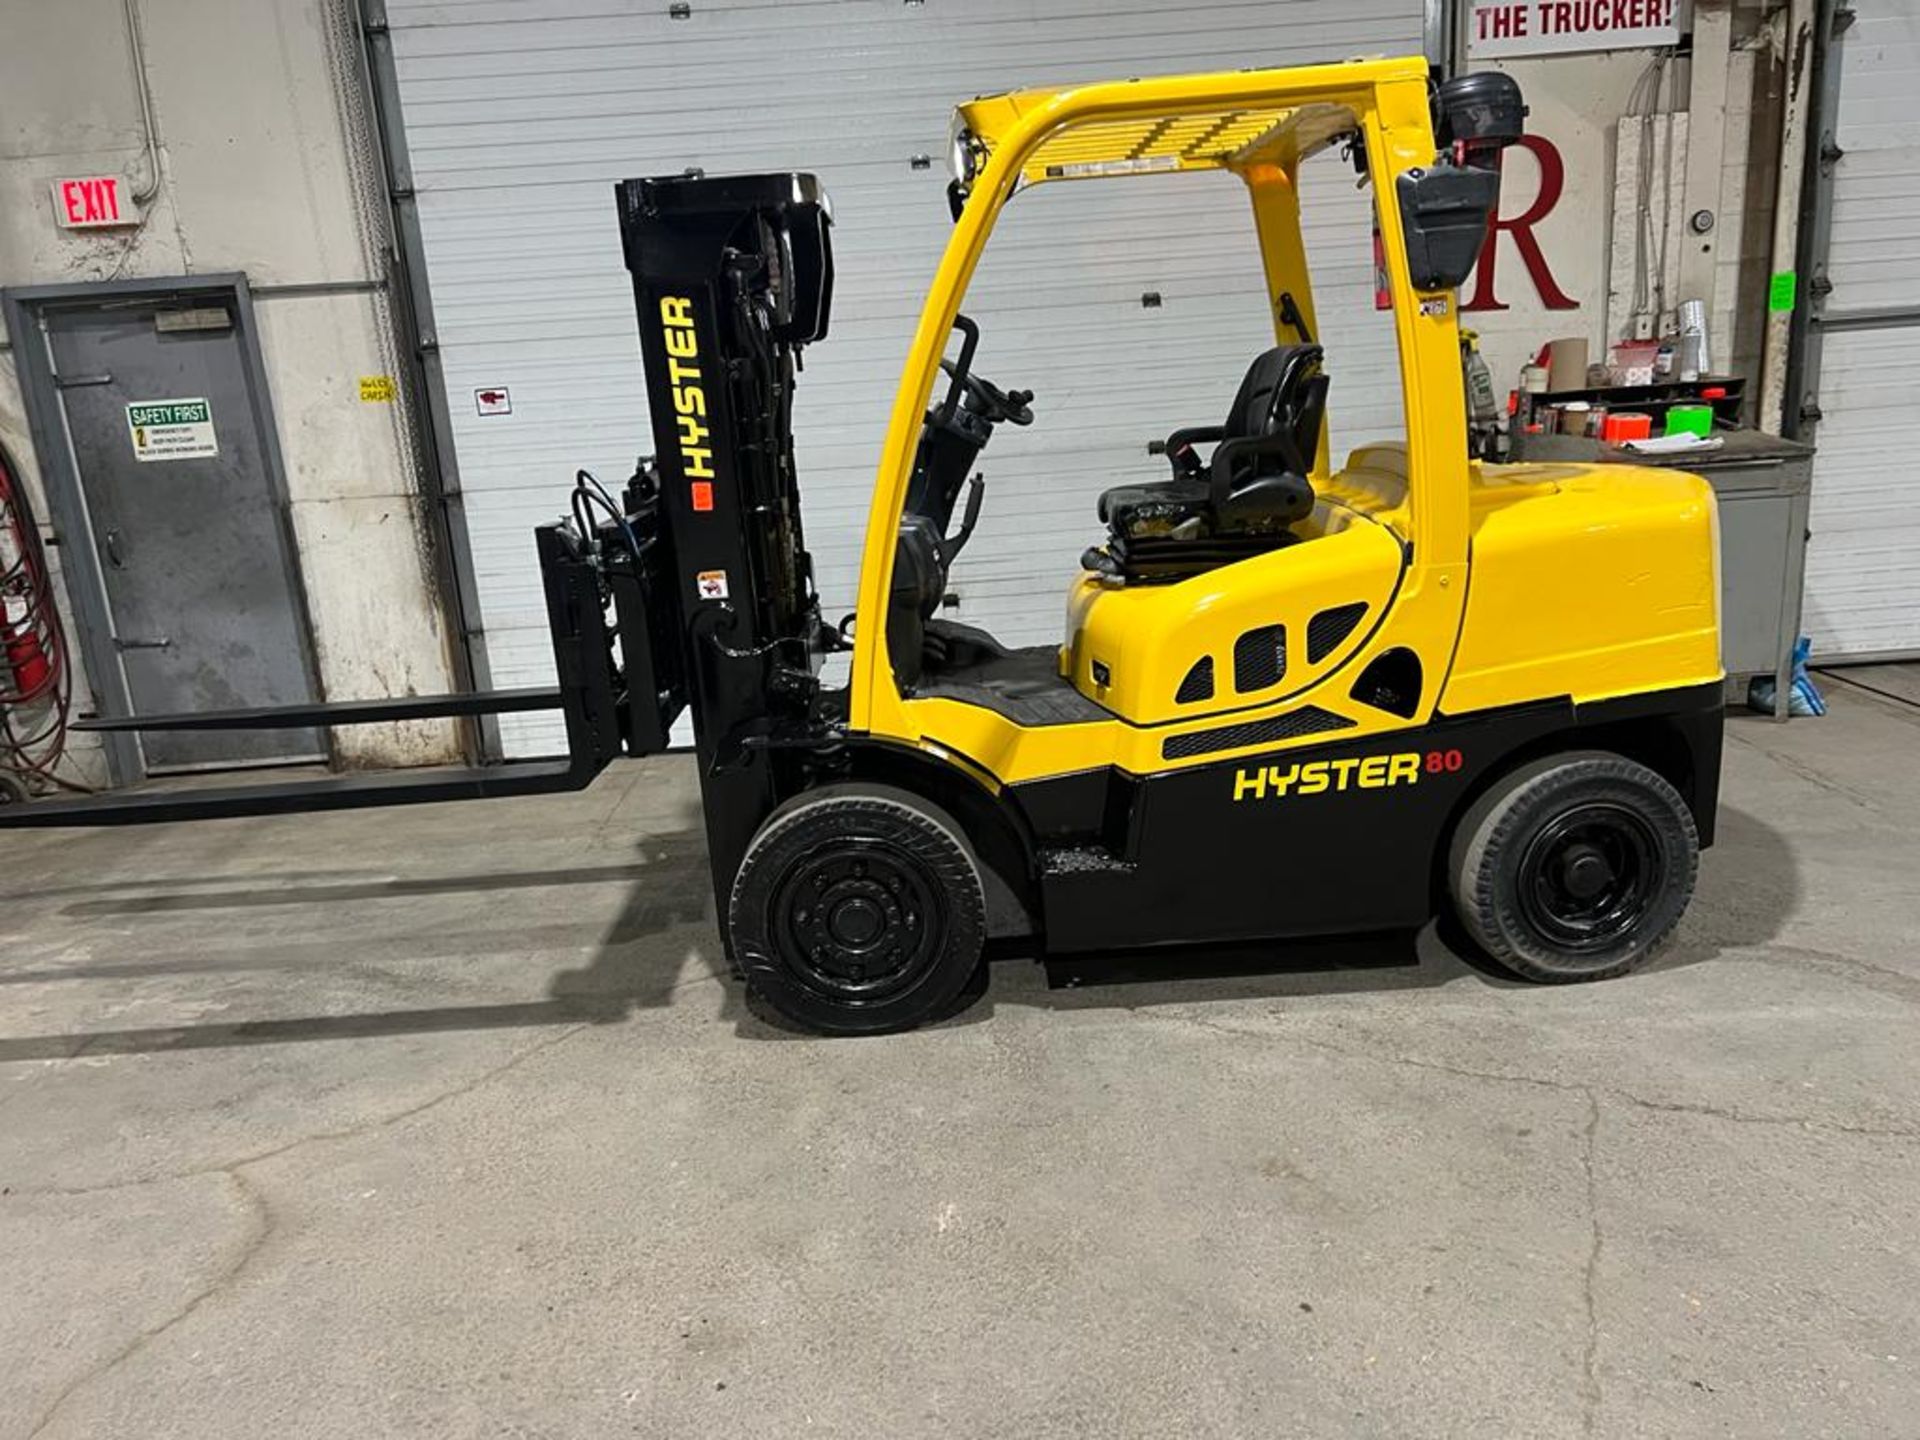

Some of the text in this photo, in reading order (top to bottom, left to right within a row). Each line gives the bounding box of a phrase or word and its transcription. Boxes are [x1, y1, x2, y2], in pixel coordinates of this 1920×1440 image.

[1476, 0, 1673, 40] THE TRUCKER!
[63, 179, 118, 223] EXIT
[660, 296, 716, 479] HYSTER
[132, 404, 205, 424] SAFETY FIRST
[1233, 750, 1464, 800] HYSTER 80
